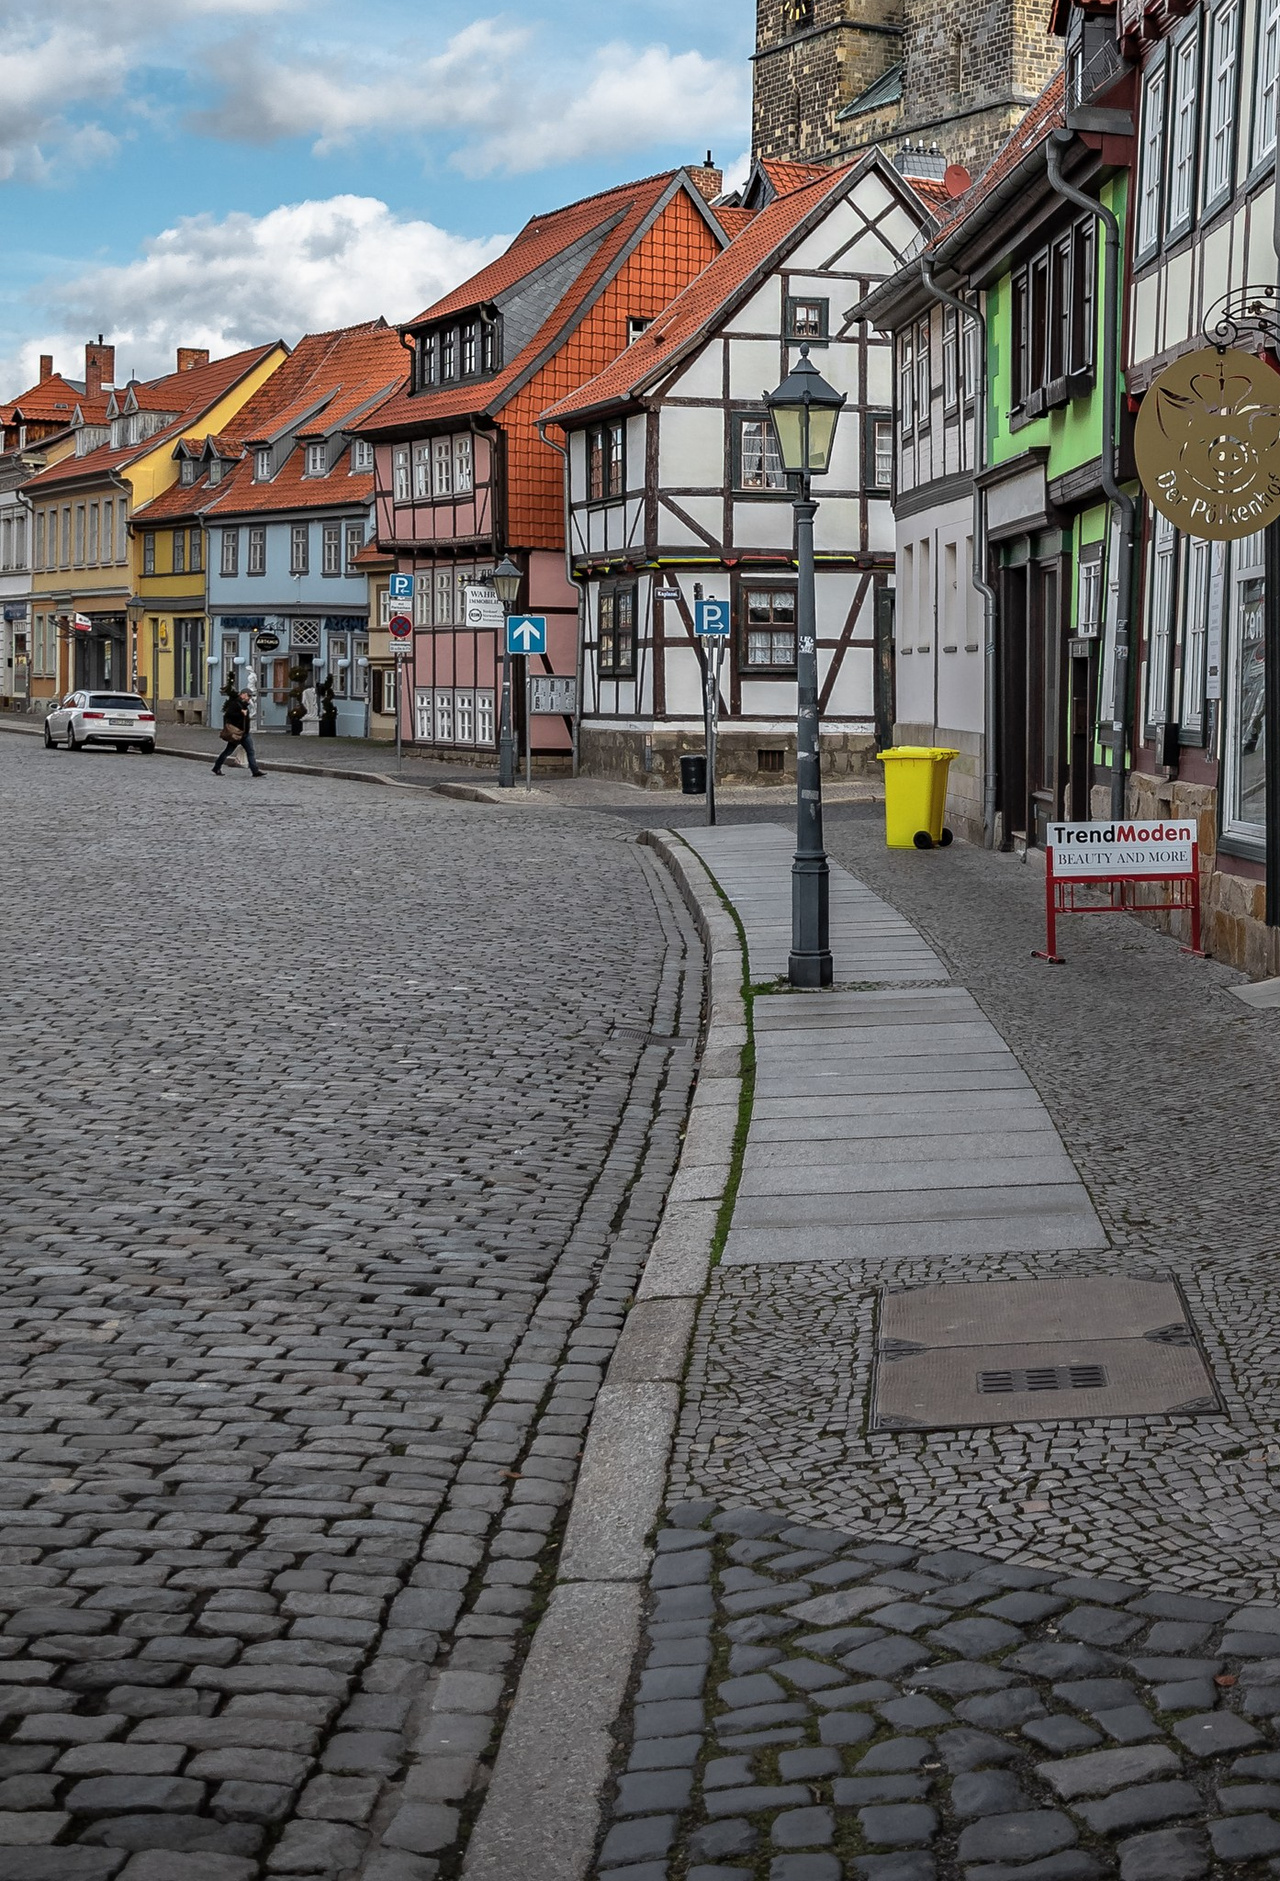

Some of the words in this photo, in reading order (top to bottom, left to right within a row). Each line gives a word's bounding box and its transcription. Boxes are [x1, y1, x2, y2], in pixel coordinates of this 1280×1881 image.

[1154, 469, 1189, 507] Der
[395, 577, 408, 594] P
[702, 604, 722, 630] P
[1053, 823, 1191, 844] TrendModen
[1058, 852, 1113, 865] BEAUTY
[1117, 852, 1145, 864] AND
[1149, 850, 1188, 863] MORE
